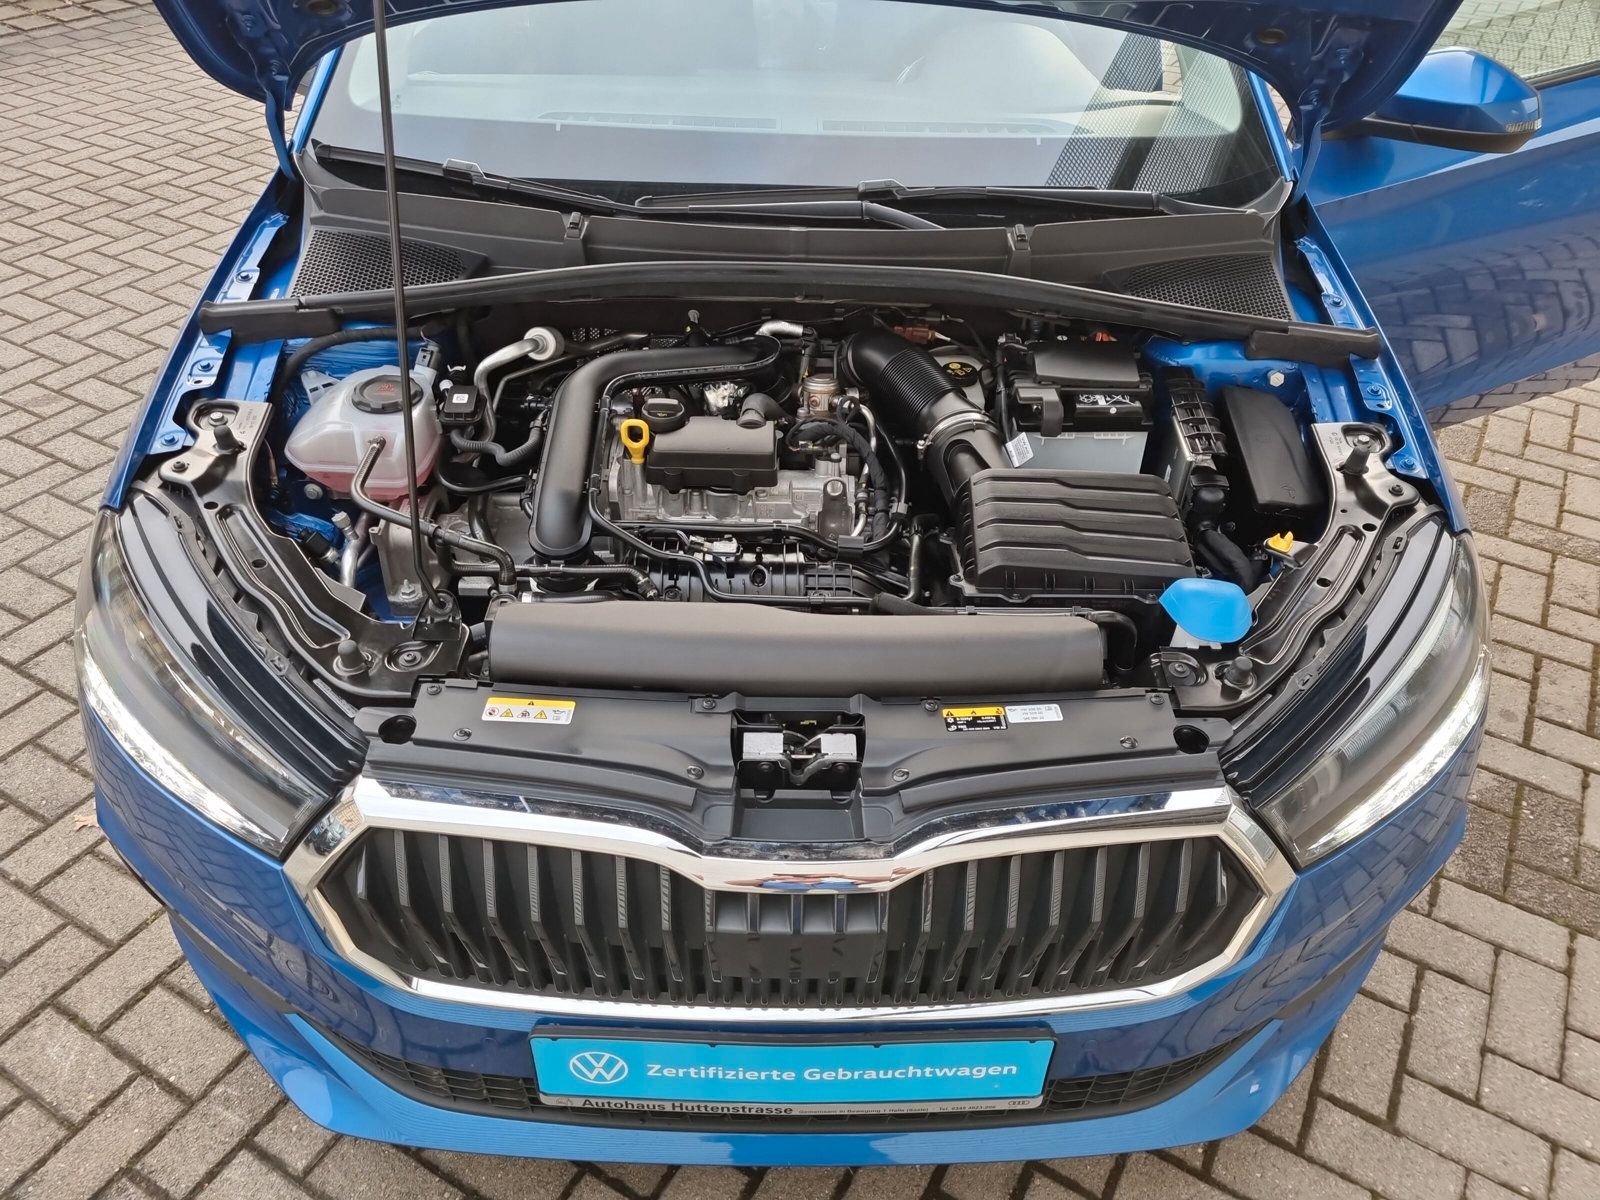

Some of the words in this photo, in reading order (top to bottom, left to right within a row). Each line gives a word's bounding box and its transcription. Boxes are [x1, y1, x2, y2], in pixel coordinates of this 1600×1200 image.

[646, 1063, 796, 1081] Zertifizierte
[803, 1064, 1018, 1081] Gebrauchtwagen
[582, 1098, 666, 1111] Autohaus
[671, 1102, 793, 1115] Huttenstrasse
